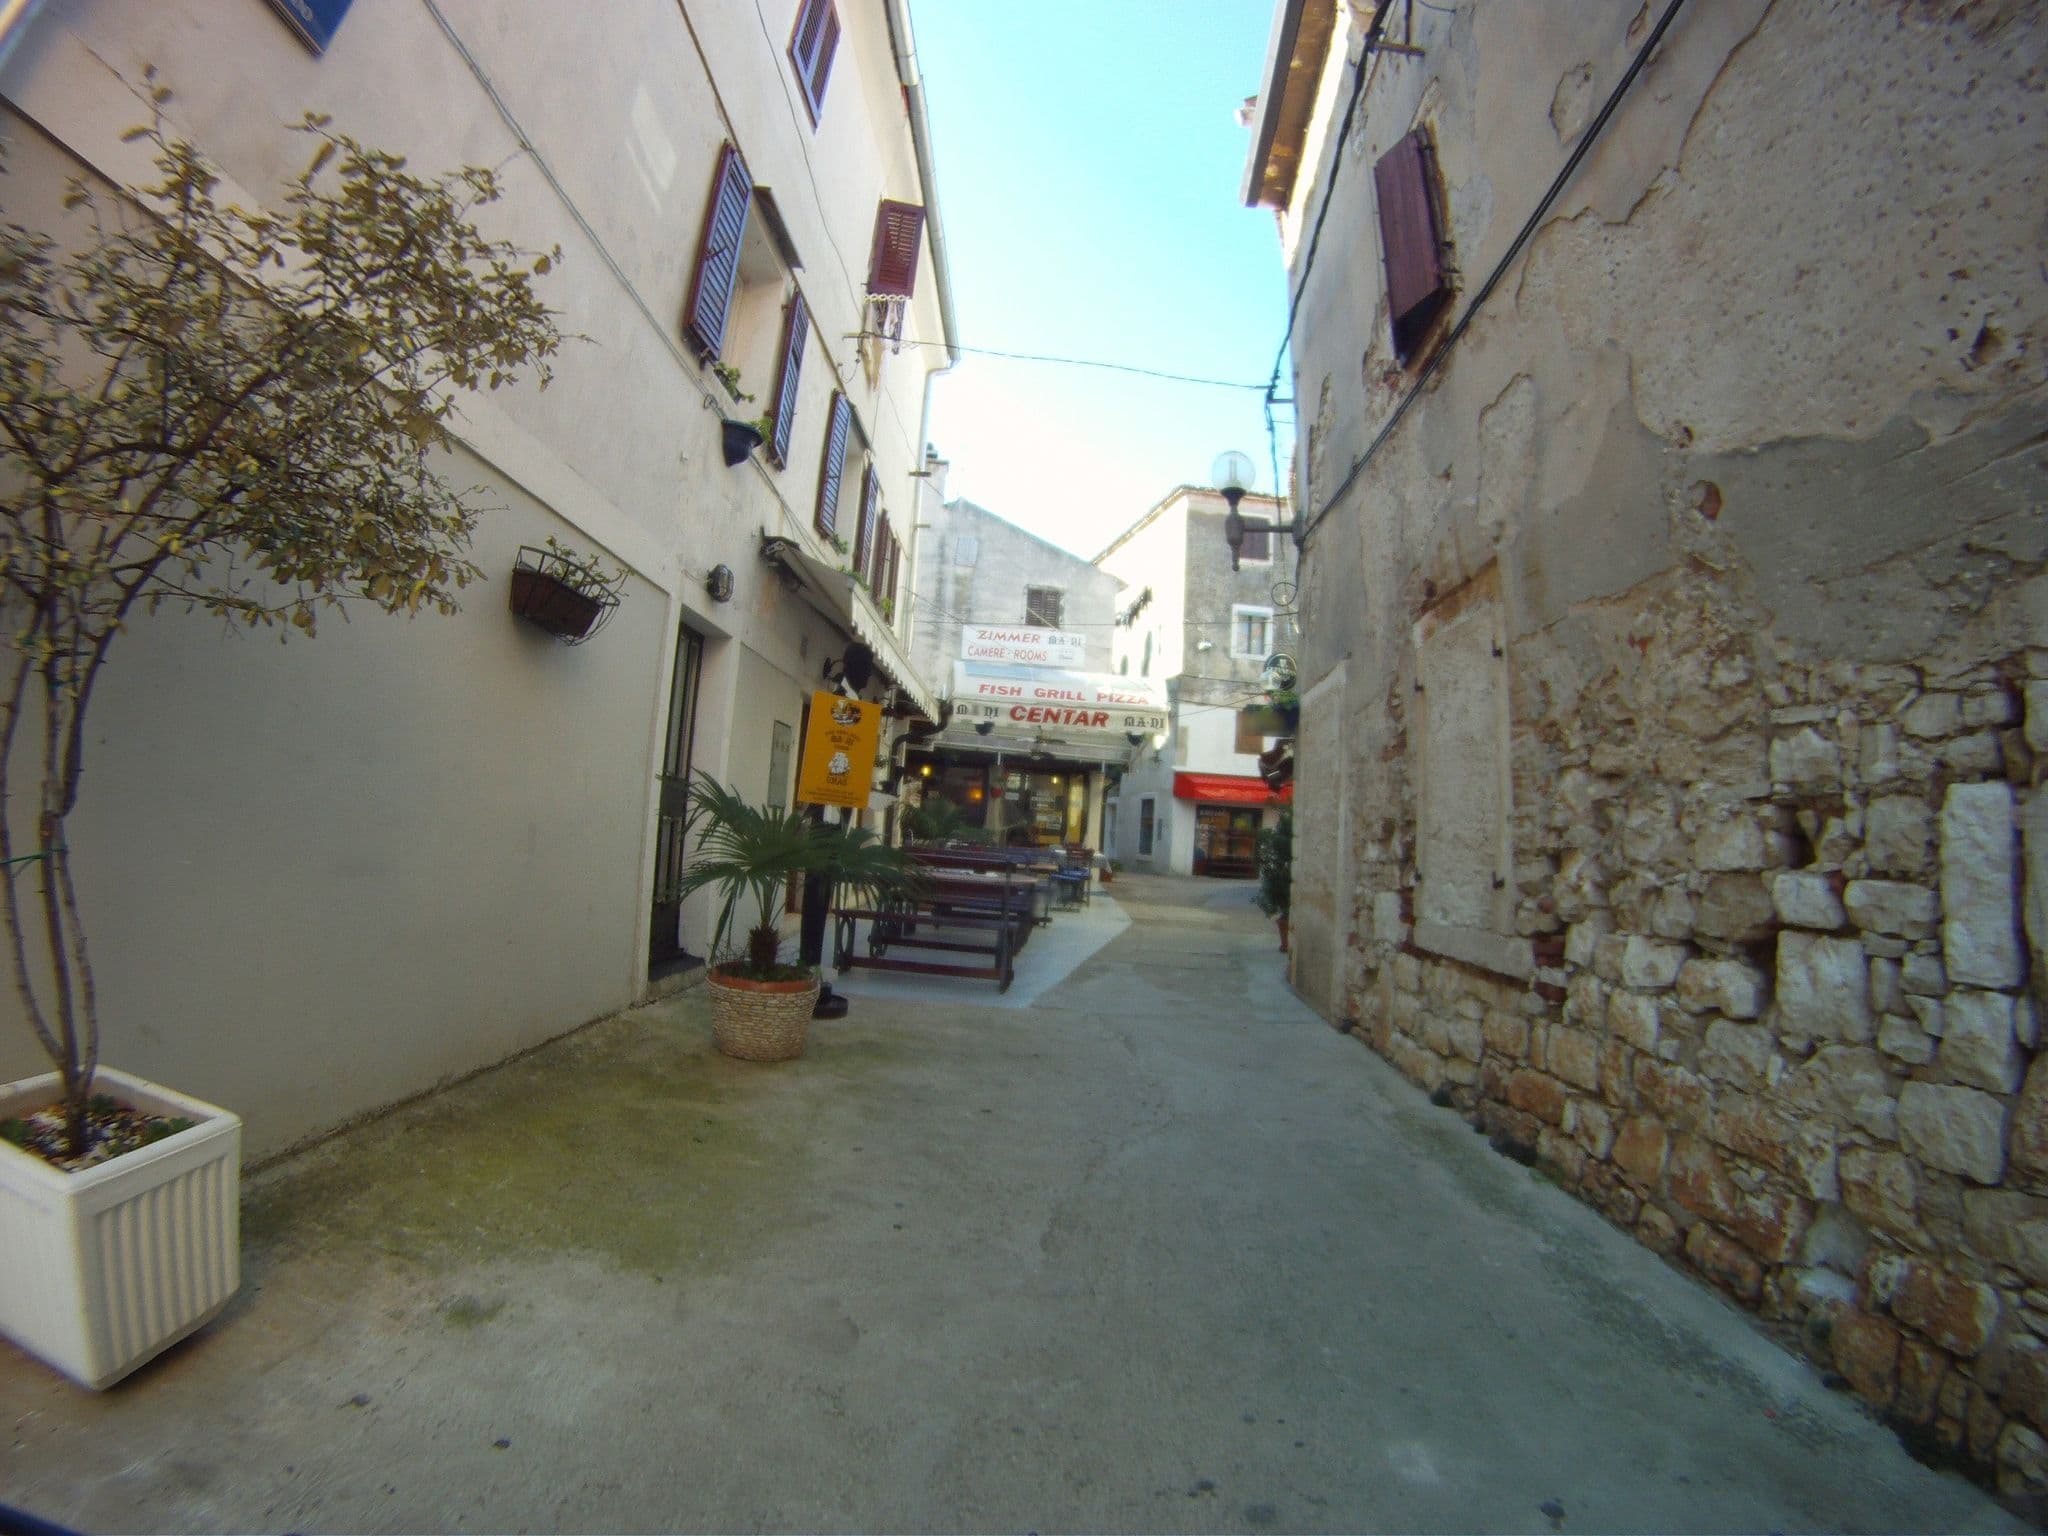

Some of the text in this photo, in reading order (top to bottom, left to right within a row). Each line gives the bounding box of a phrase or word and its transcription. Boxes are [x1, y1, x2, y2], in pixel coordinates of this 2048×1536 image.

[977, 629, 1041, 644] ZIMMER
[967, 645, 1006, 659] CAMERE
[1013, 650, 1048, 662] ROOMS
[978, 684, 1150, 705] FISH GRILL PIZZA
[1009, 704, 1110, 728] CENTAR
